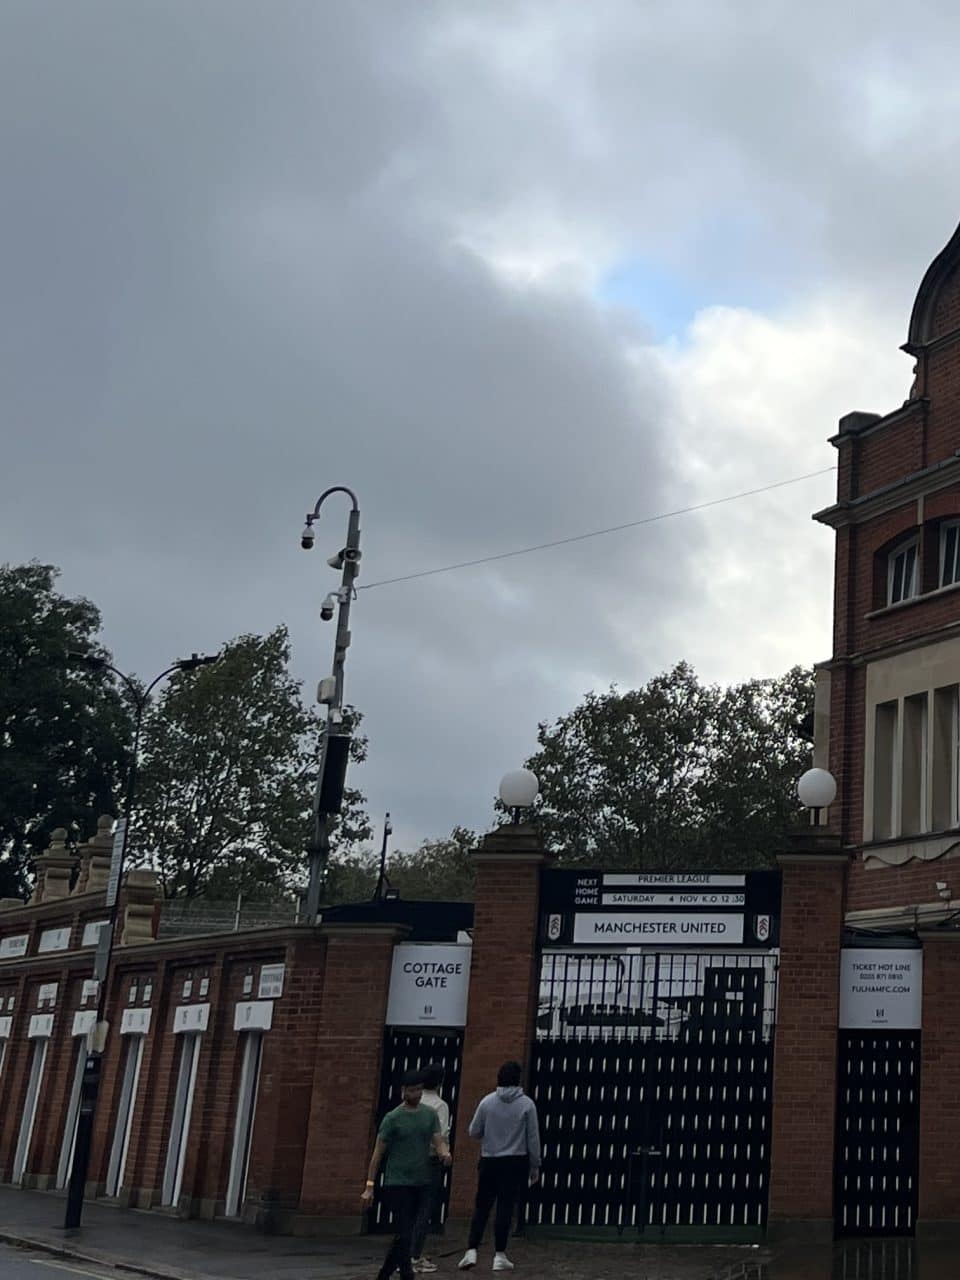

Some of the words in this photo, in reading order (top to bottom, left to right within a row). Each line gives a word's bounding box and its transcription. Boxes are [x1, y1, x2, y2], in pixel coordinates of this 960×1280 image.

[577, 878, 598, 886] NEXT
[638, 874, 673, 883] PREMIER
[677, 874, 711, 883] LEAGUE
[575, 887, 599, 895] HOME
[574, 896, 598, 905] GAME
[612, 895, 655, 903] SATURDAY
[680, 895, 698, 903] NOV
[594, 922, 677, 933] MANCHESTER
[680, 922, 727, 933] UNITED
[403, 962, 462, 974] COTTAGE
[852, 963, 876, 971] TICKET
[878, 963, 893, 971] HOT
[895, 963, 911, 972] LINE
[415, 976, 448, 988] GATE
[852, 985, 911, 993] FULHAMFC.COM
